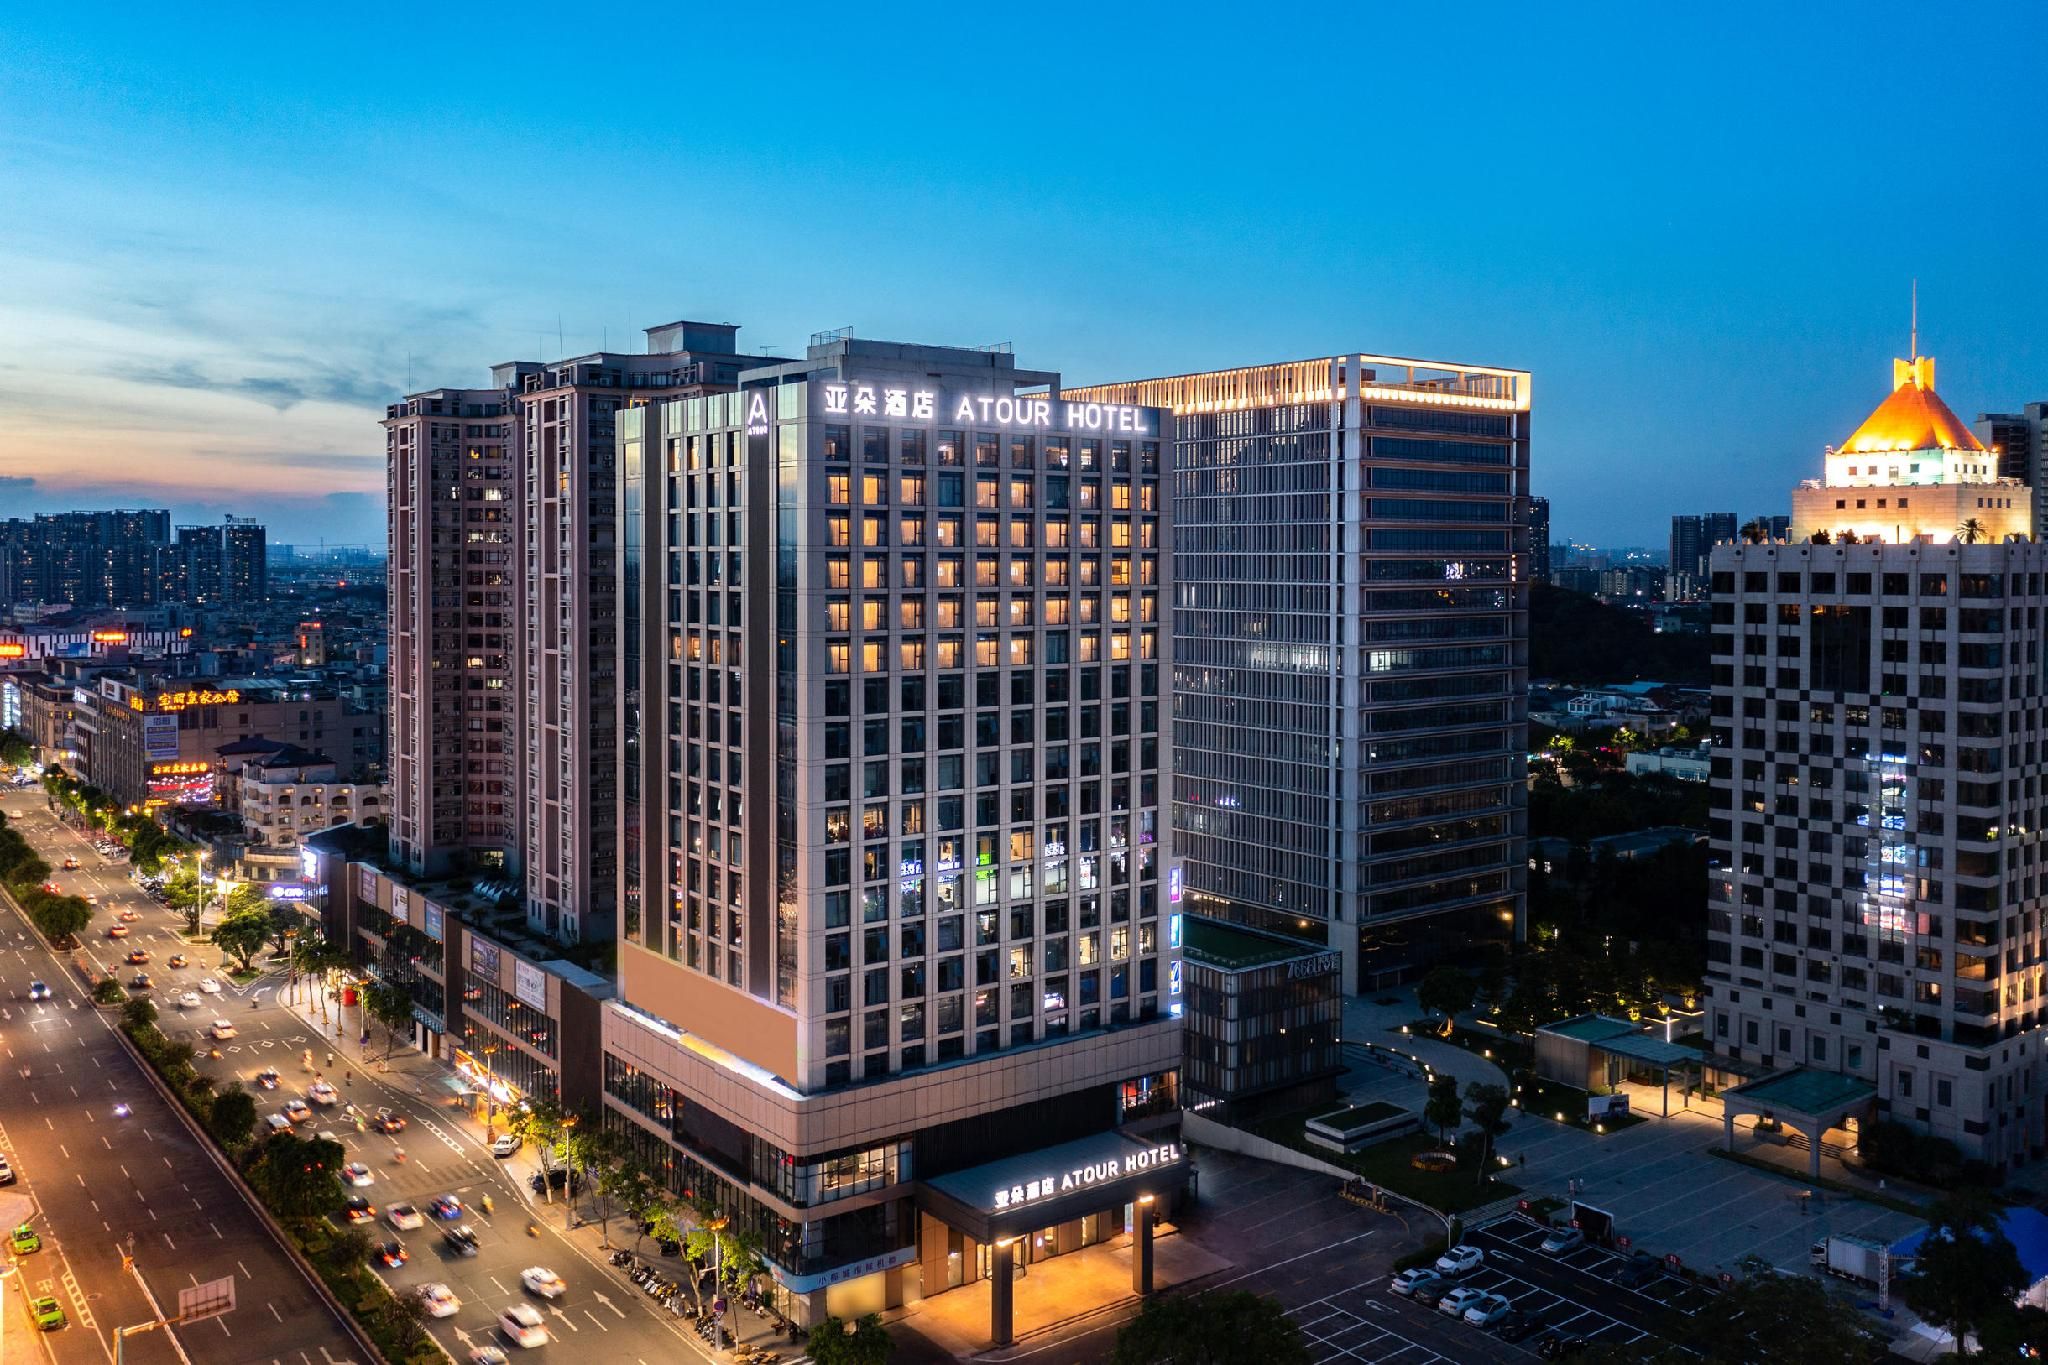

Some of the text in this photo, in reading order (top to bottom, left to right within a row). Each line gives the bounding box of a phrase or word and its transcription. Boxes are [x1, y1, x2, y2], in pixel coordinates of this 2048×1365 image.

[825, 386, 1147, 432] 亚朵酒店 ATOUR HOTEL
[994, 1143, 1179, 1209] 亚朵酒店 ATOUR HOTEL
